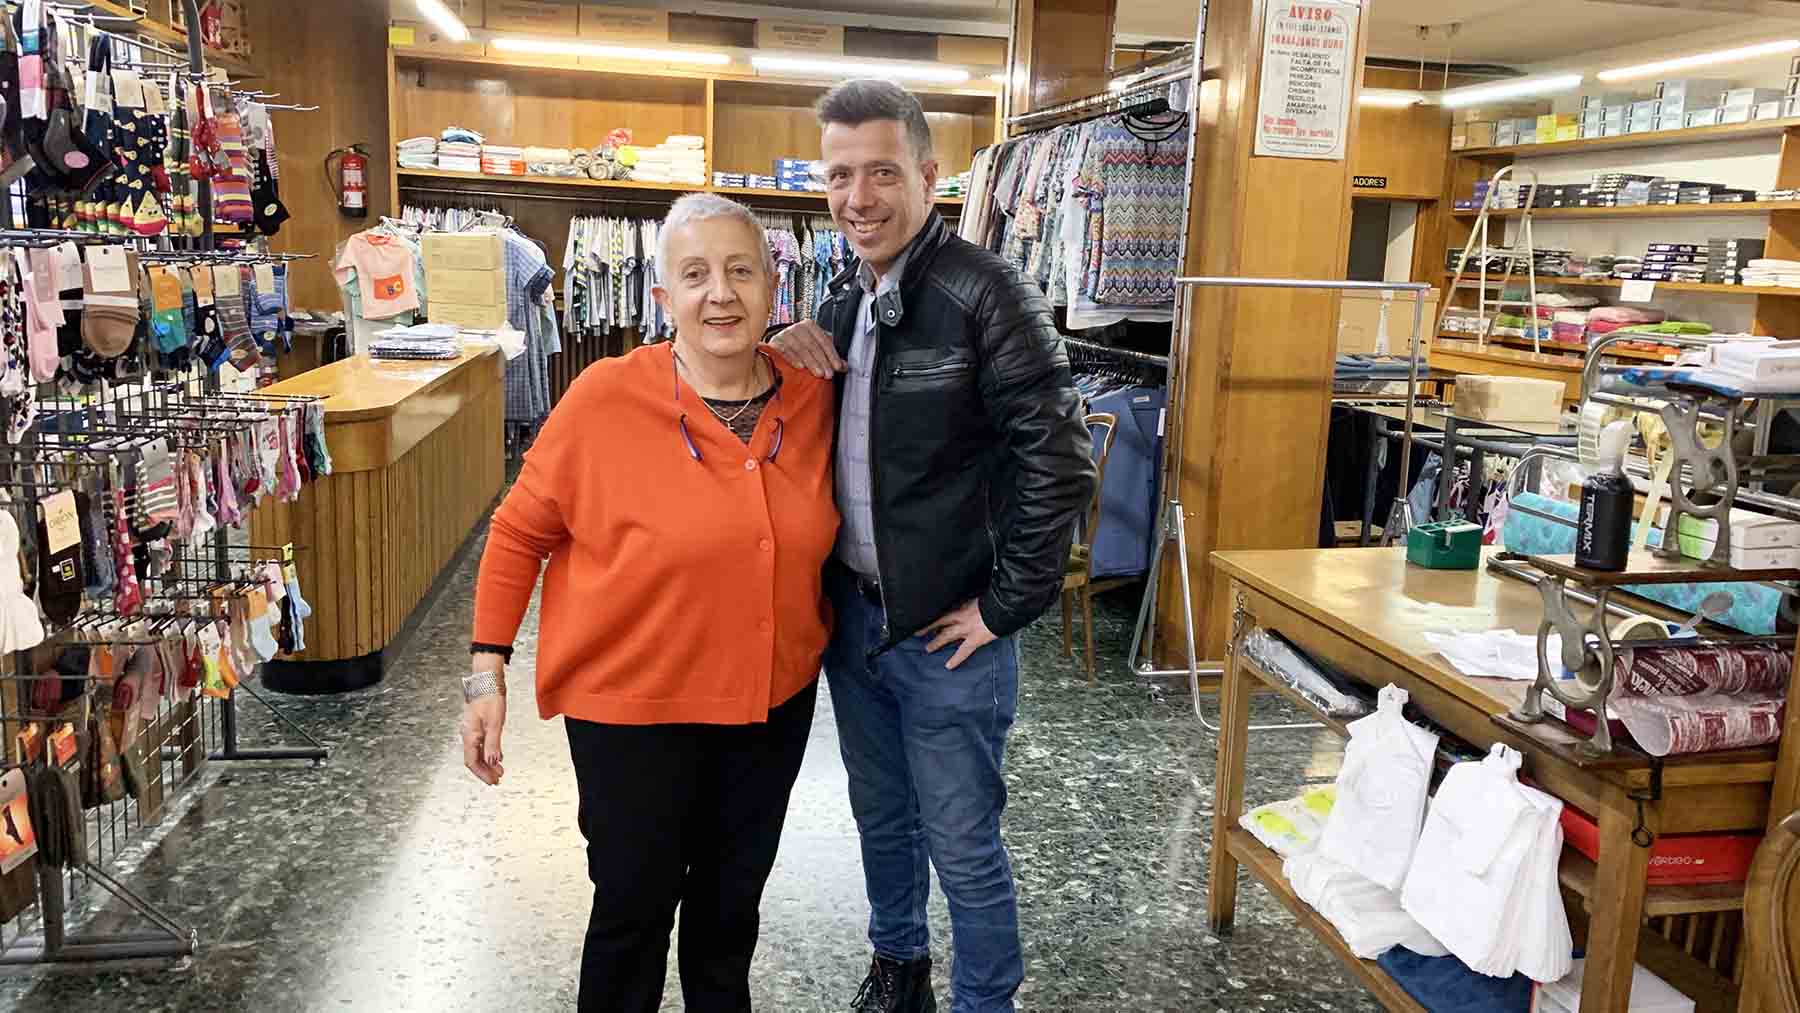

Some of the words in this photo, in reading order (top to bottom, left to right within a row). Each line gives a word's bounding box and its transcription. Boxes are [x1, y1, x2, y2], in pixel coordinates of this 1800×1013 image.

[1288, 5, 1332, 21] AVISO
[1290, 58, 1311, 66] FALTA
[1353, 177, 1385, 187] ADORES
[1583, 494, 1596, 554] TERMIX
